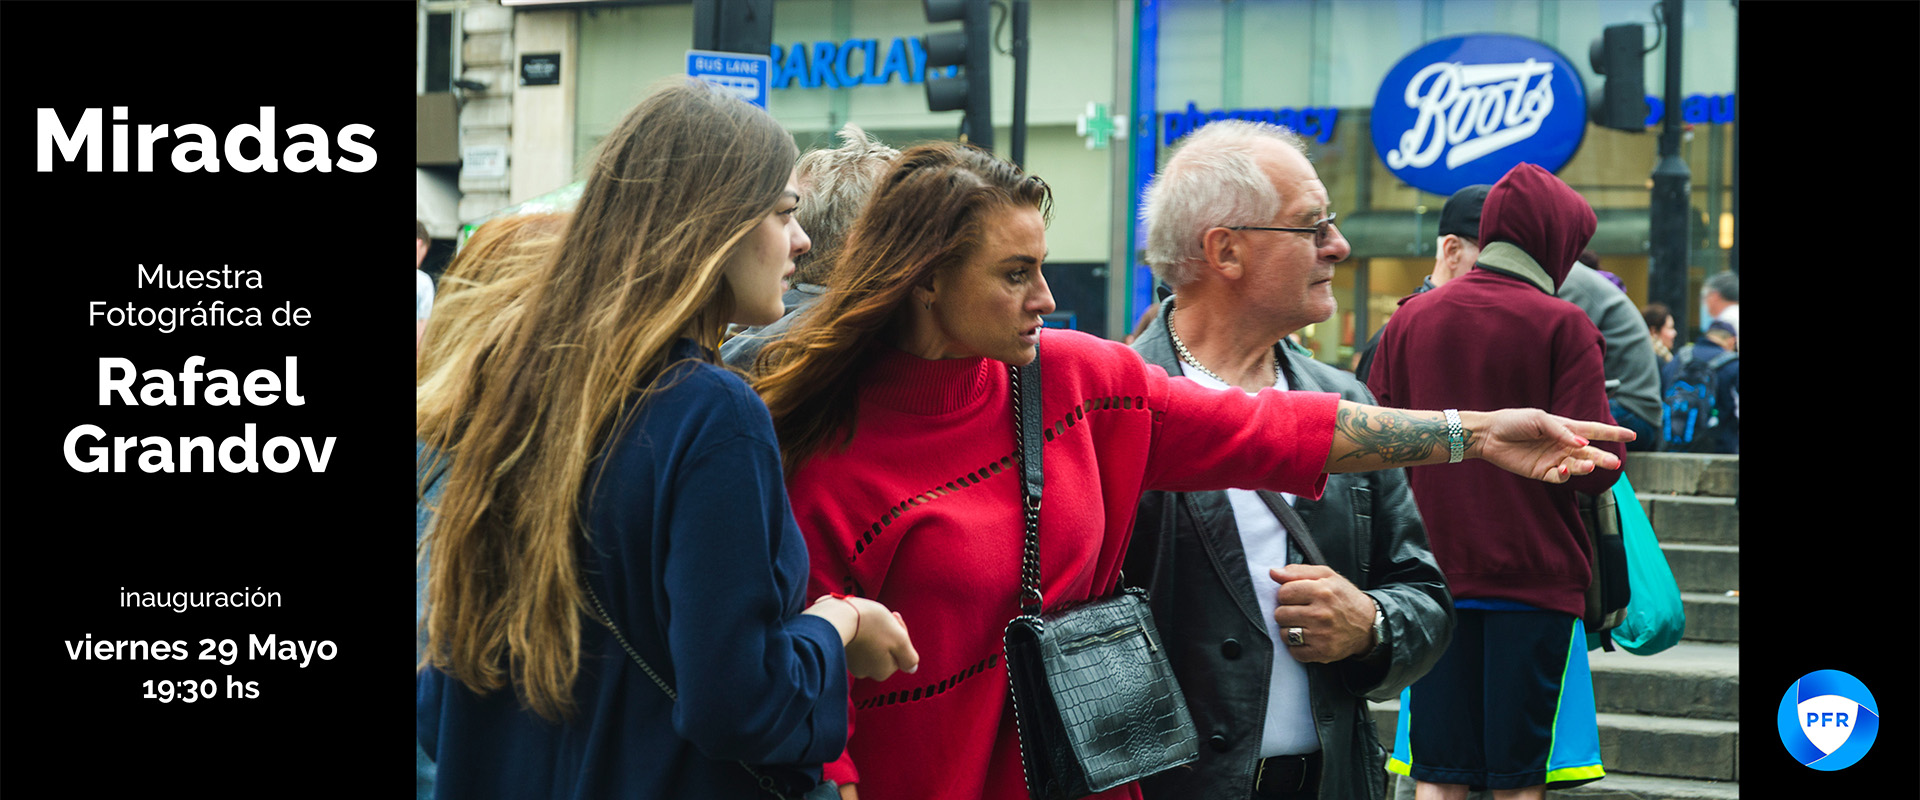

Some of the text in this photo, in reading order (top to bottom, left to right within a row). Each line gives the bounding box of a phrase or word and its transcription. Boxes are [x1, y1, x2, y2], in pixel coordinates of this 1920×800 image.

[695, 57, 760, 75] BUS LANE
[1387, 58, 1554, 169] Boots
